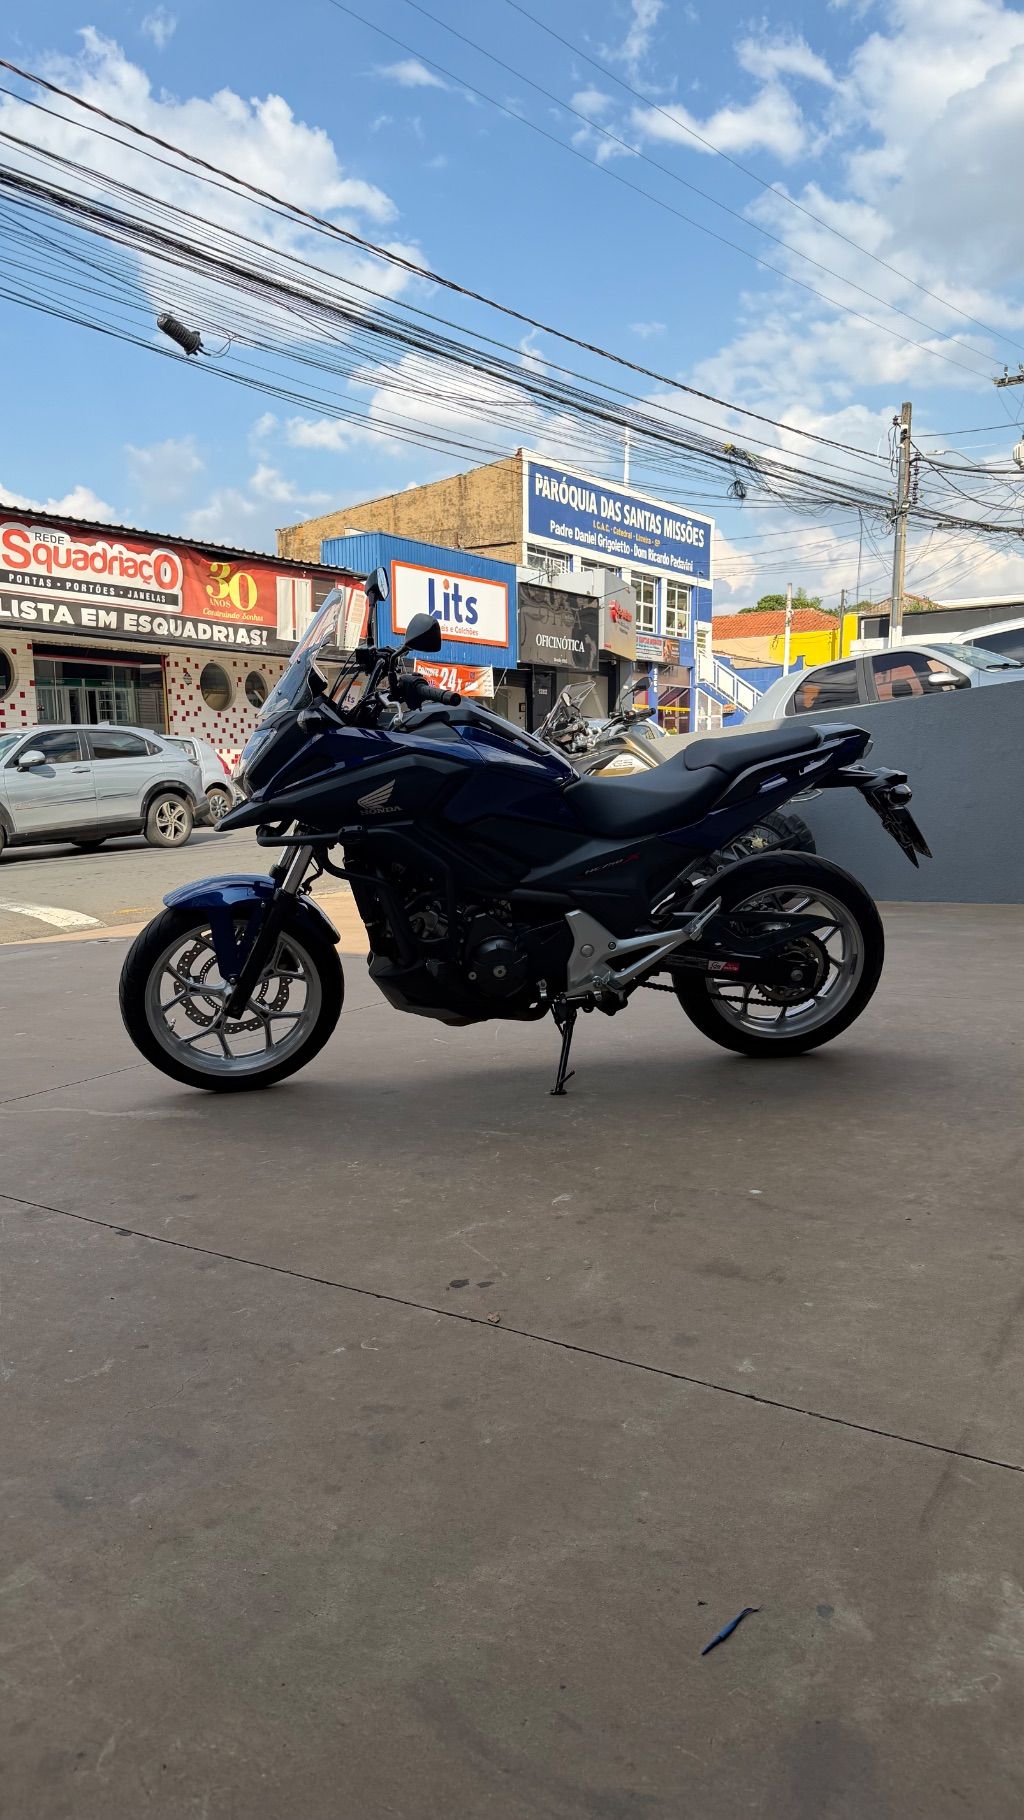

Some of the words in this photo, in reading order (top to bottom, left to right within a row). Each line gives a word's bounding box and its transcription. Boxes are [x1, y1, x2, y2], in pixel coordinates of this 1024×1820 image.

[535, 473, 598, 515] PARÓQUIA
[600, 496, 622, 522] DAS
[623, 505, 662, 535] SANTAS
[663, 517, 705, 548] MISSÕES
[34, 532, 65, 545] REDE
[550, 520, 574, 539] Padre
[574, 527, 597, 546] Daniel
[598, 533, 630, 555] Grigoletto
[634, 543, 648, 560] Dom
[648, 548, 670, 566] Ricardo
[9, 573, 52, 588] PORTAS
[66, 582, 116, 596] PORTÕES
[127, 590, 166, 603] JANELAS
[206, 562, 258, 611] 30
[428, 577, 478, 625] Lits
[209, 598, 231, 609] ANOS
[80, 607, 118, 630] EM
[123, 612, 268, 646] ESQUADRIAS!
[454, 626, 479, 636] Colchões
[535, 633, 585, 653] OFICINÓTICA
[360, 806, 403, 816] HONDA
